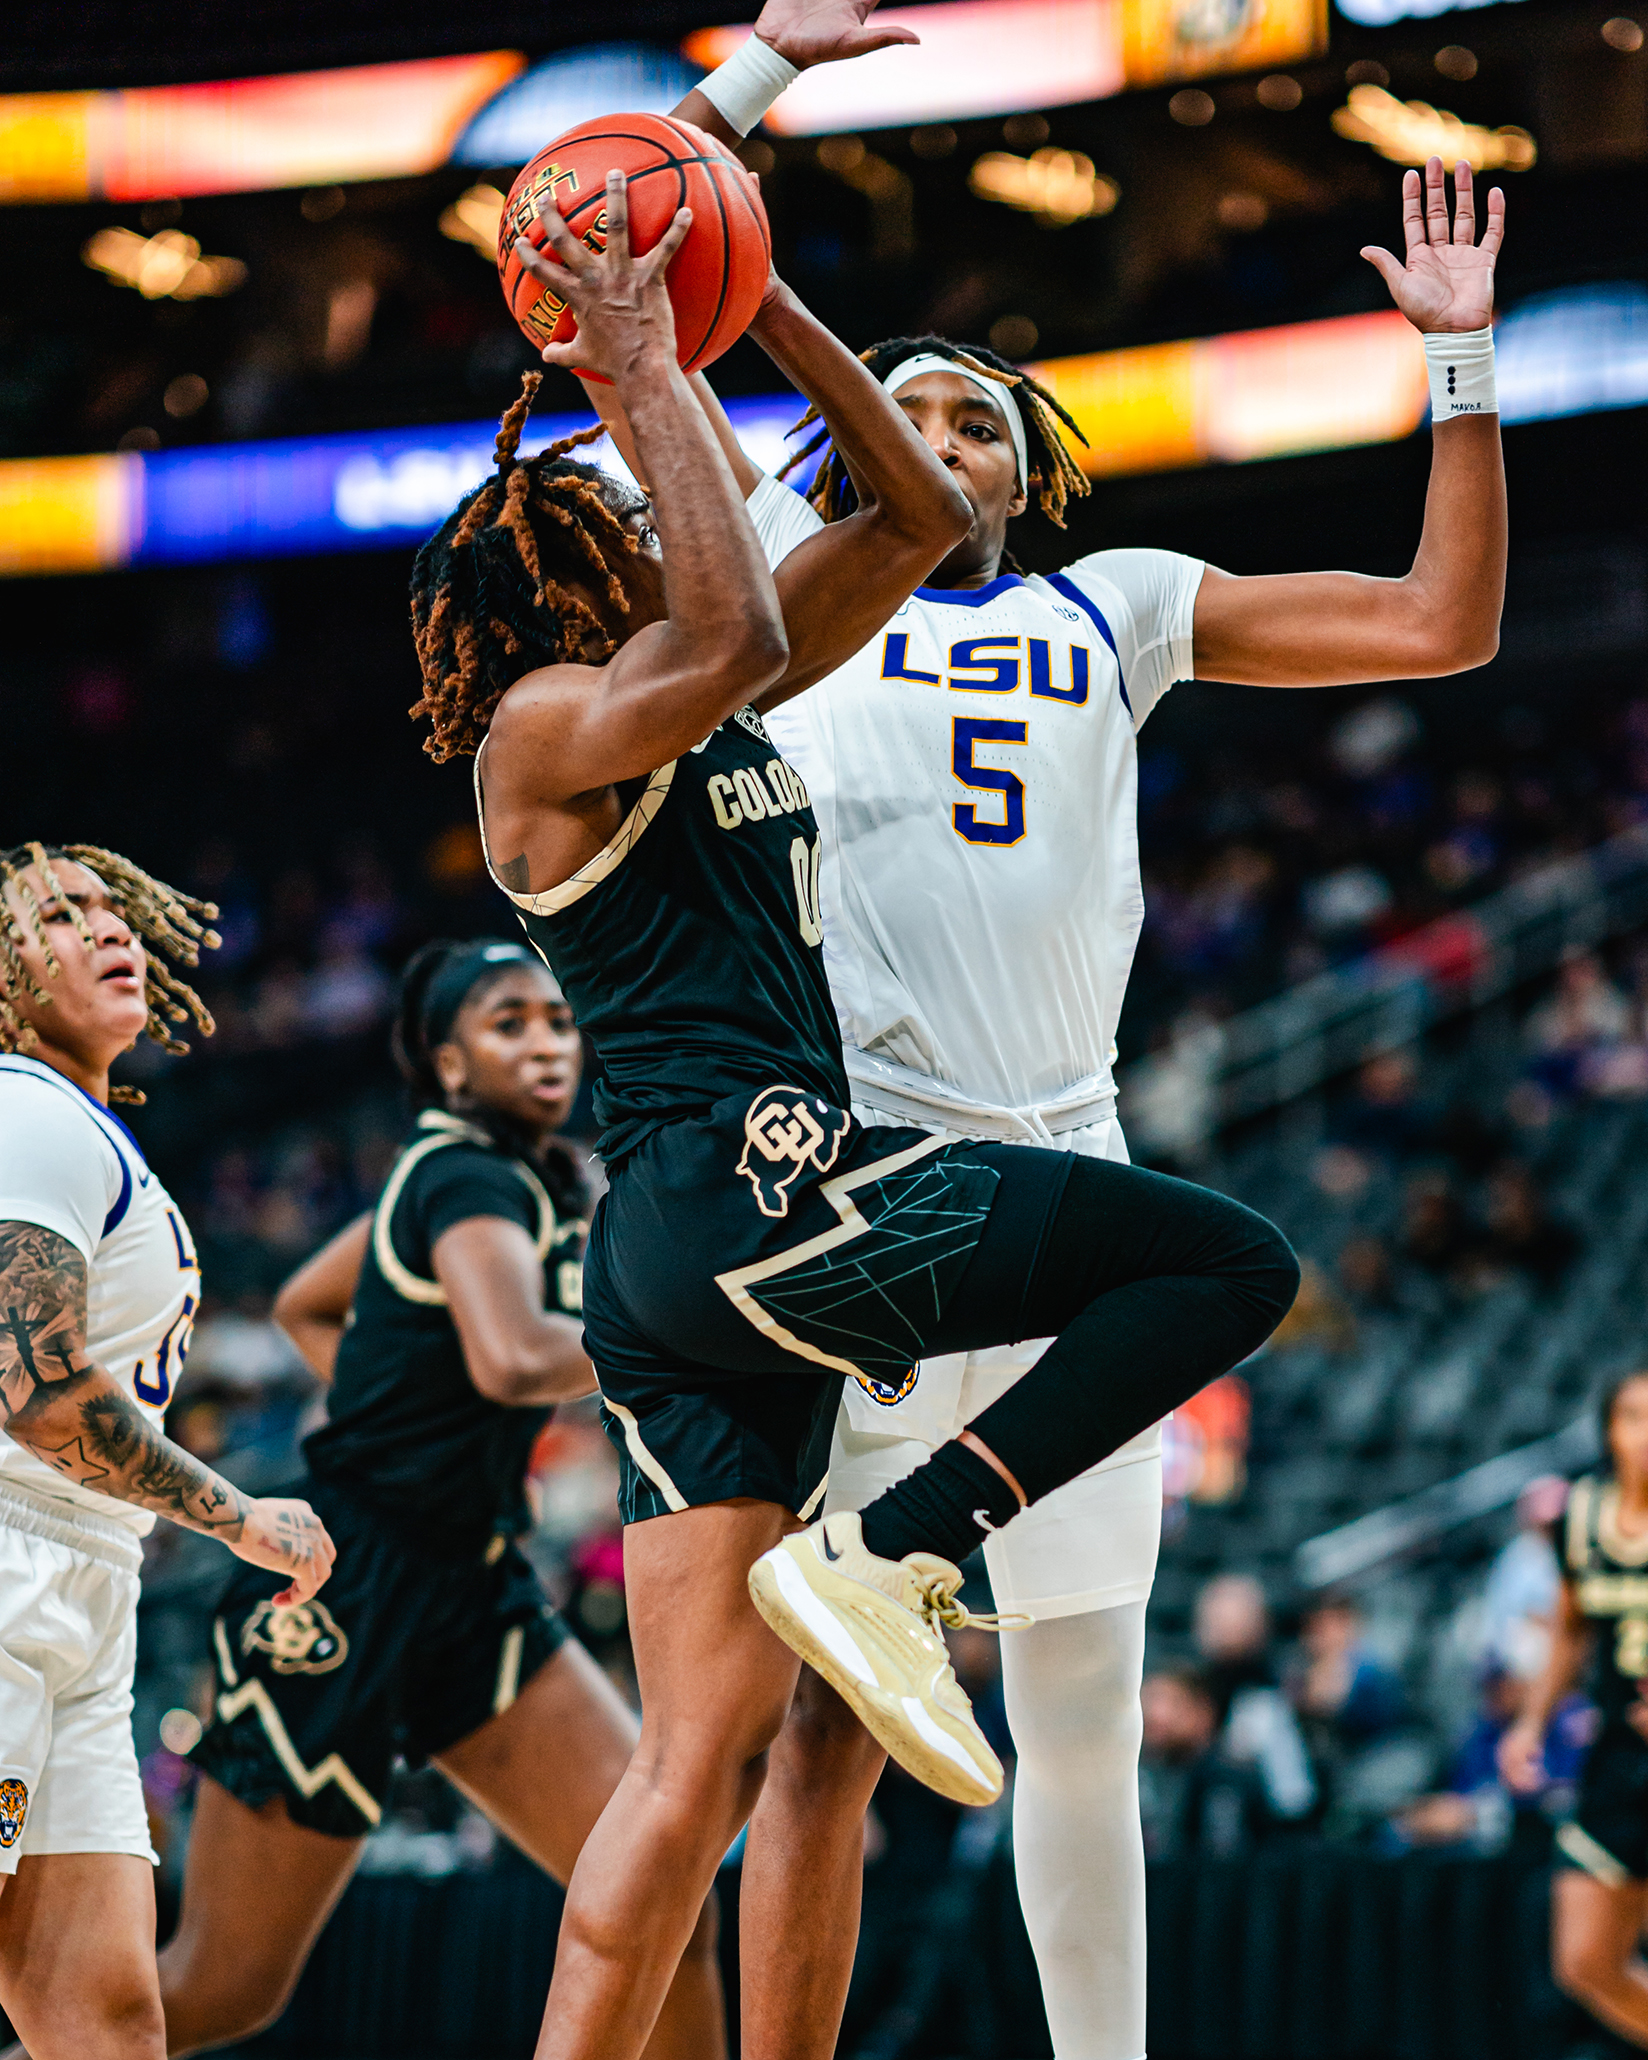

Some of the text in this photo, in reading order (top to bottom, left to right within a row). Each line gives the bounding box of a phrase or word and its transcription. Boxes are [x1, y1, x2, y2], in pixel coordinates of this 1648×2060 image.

[879, 632, 1090, 708] LSU
[706, 757, 811, 830] COLOR
[950, 715, 1029, 848] 5
